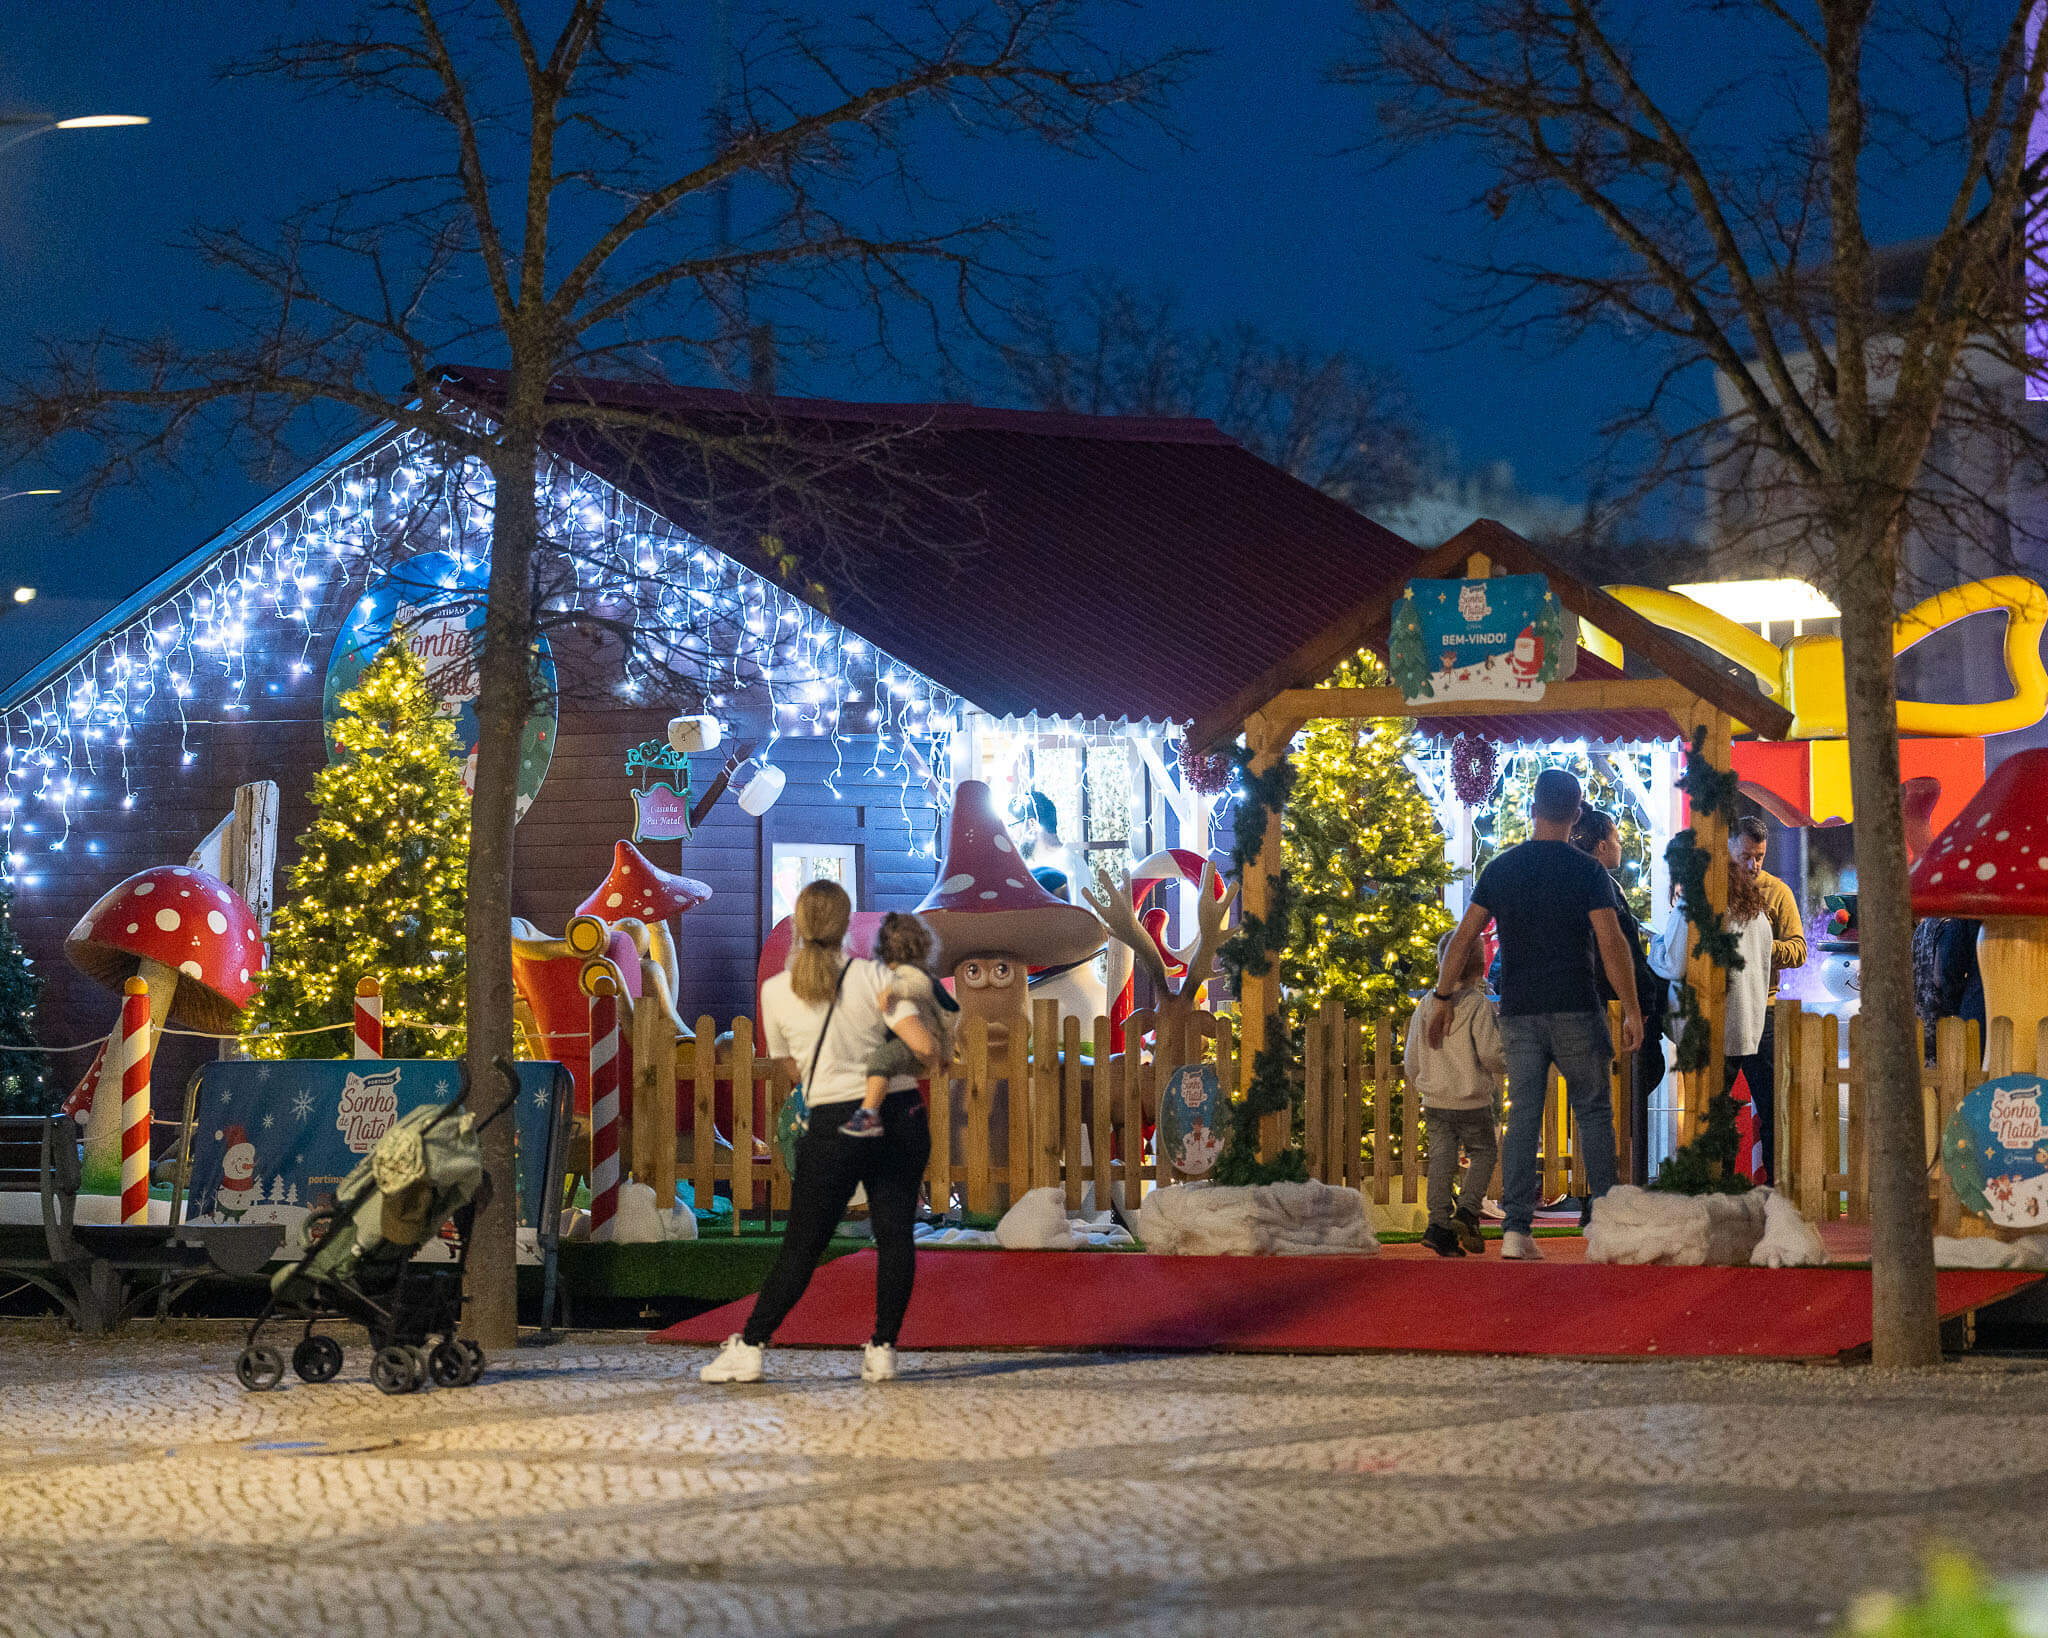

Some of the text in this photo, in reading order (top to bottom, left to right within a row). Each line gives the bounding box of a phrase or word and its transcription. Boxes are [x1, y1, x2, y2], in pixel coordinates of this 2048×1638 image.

[409, 621, 469, 658] onho
[1442, 633, 1507, 646] BEM-VINDO!
[646, 816, 682, 826] Pai Natal
[341, 1087, 395, 1113] Sonho
[1991, 1100, 2037, 1119] Sonho
[2000, 1119, 2039, 1139] Natal
